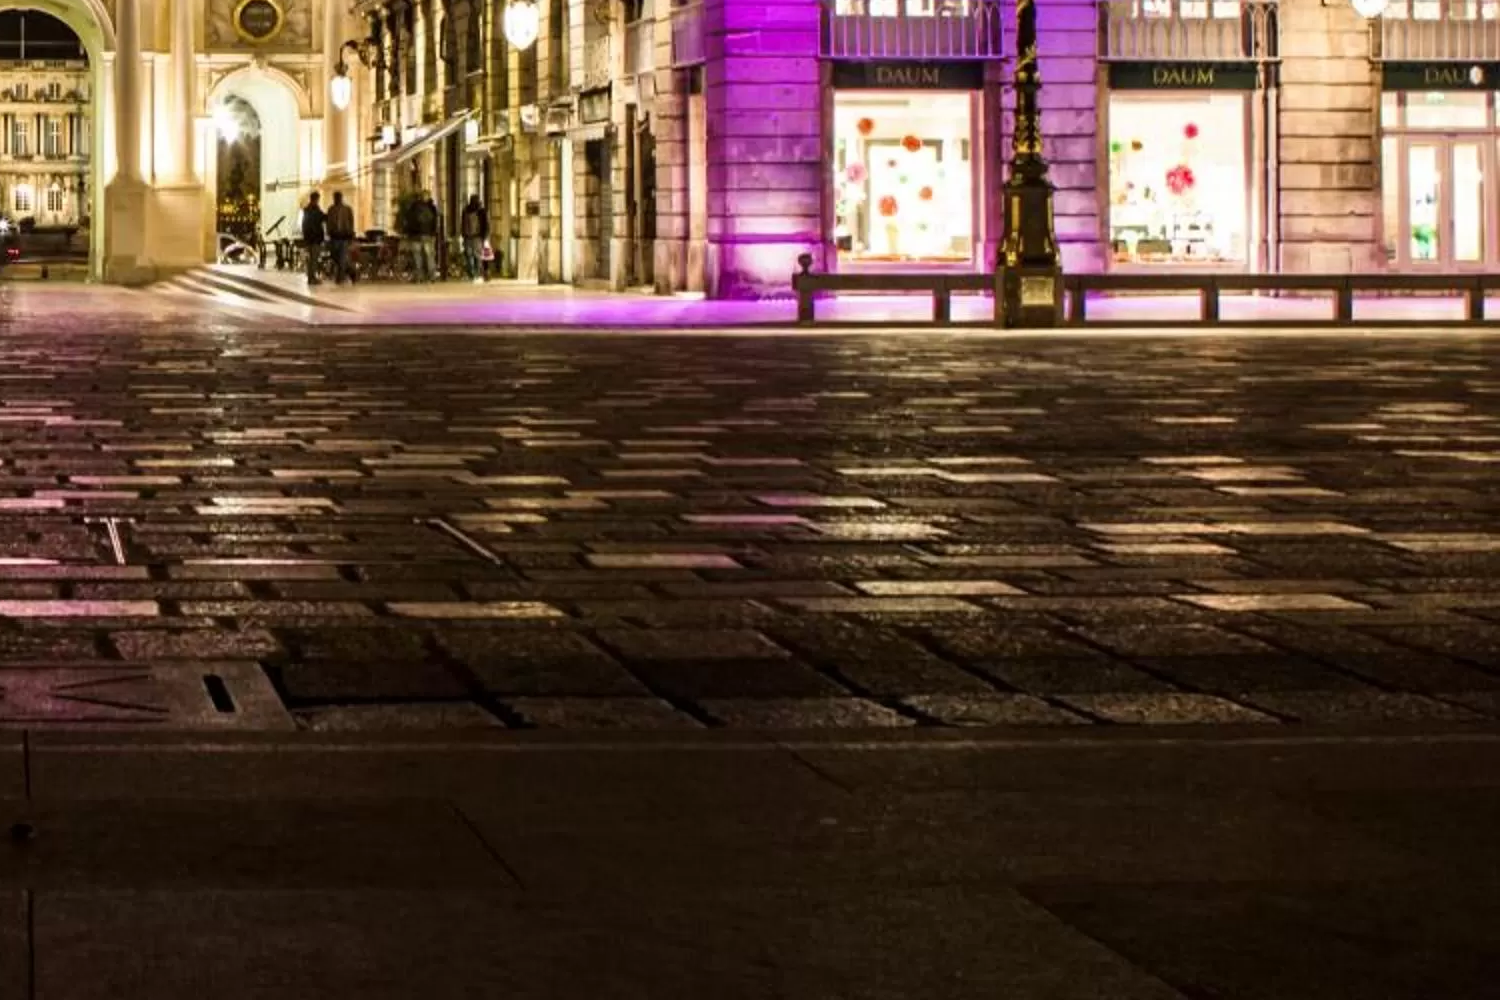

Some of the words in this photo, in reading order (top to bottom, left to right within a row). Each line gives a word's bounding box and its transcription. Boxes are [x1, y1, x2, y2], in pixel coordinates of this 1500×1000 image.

[876, 67, 939, 84] DAUM
[1153, 67, 1214, 85] DAUM
[1425, 67, 1483, 85] DAU
